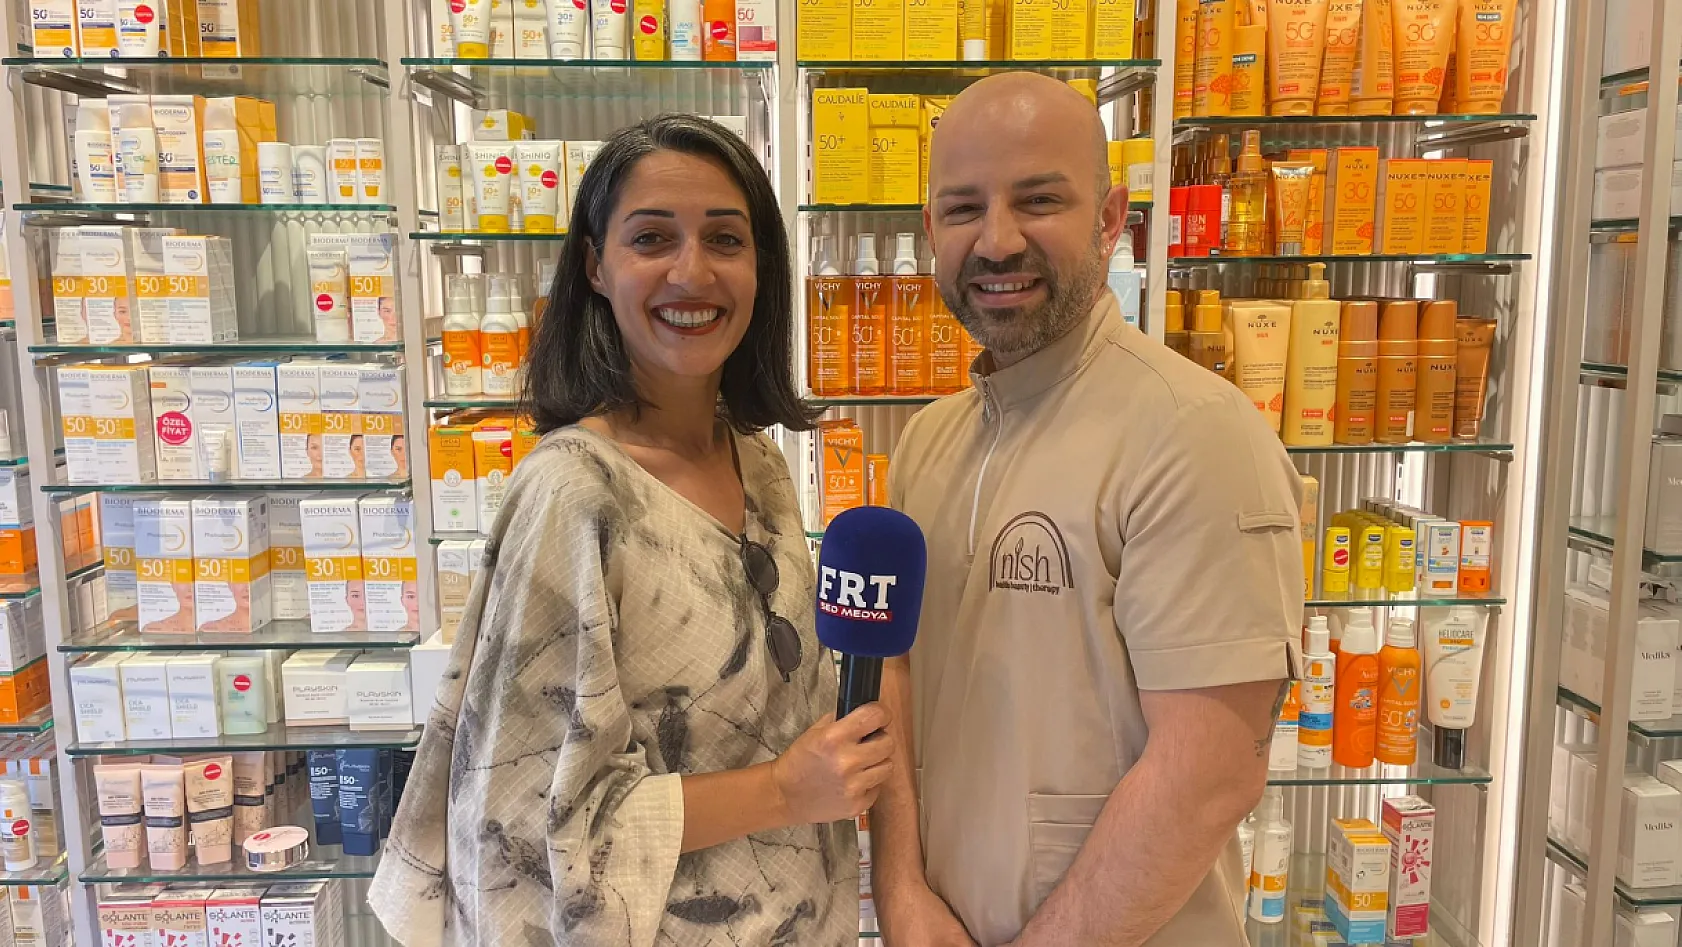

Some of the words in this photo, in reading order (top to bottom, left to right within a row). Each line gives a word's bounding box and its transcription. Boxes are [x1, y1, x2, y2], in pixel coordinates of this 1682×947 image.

[819, 134, 846, 149] 50+
[872, 138, 898, 153] 50+
[815, 283, 841, 291] VICHY
[162, 416, 186, 427] ÖZEL
[827, 438, 858, 446] VICHY
[304, 507, 352, 515] BIODERMA
[312, 559, 334, 576] 30
[368, 559, 390, 576] 30
[819, 565, 897, 610] FRT
[840, 608, 888, 620] MEDYA
[1387, 666, 1416, 676] VICHY
[154, 911, 201, 922] SOLANTE
[209, 910, 256, 921] SOLANTE
[263, 910, 311, 922] SOLANTE
